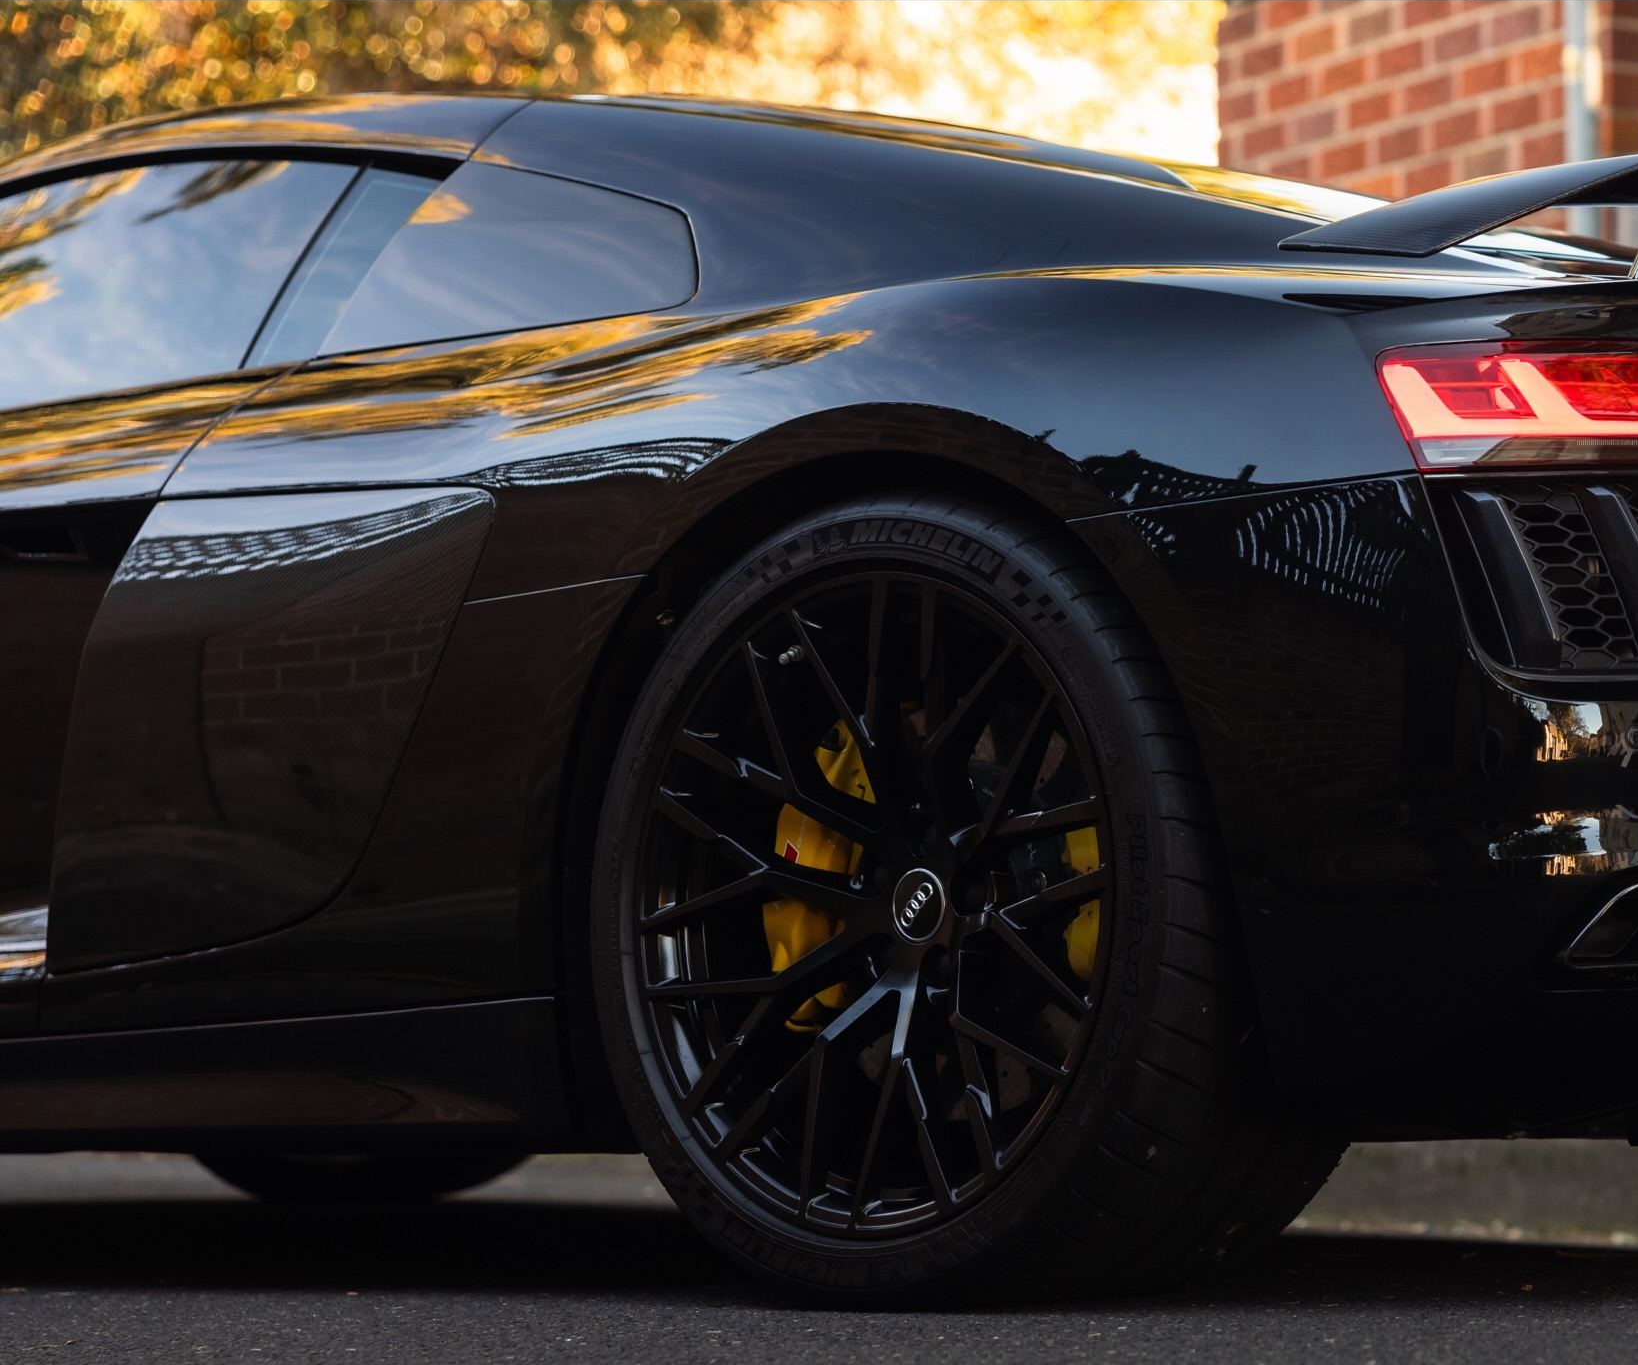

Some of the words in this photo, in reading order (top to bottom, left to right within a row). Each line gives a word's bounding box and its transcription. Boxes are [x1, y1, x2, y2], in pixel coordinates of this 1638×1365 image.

[849, 520, 1003, 574] MICHELIN
[1127, 813, 1148, 895] Pilot
[1123, 899, 1148, 998] Sport
